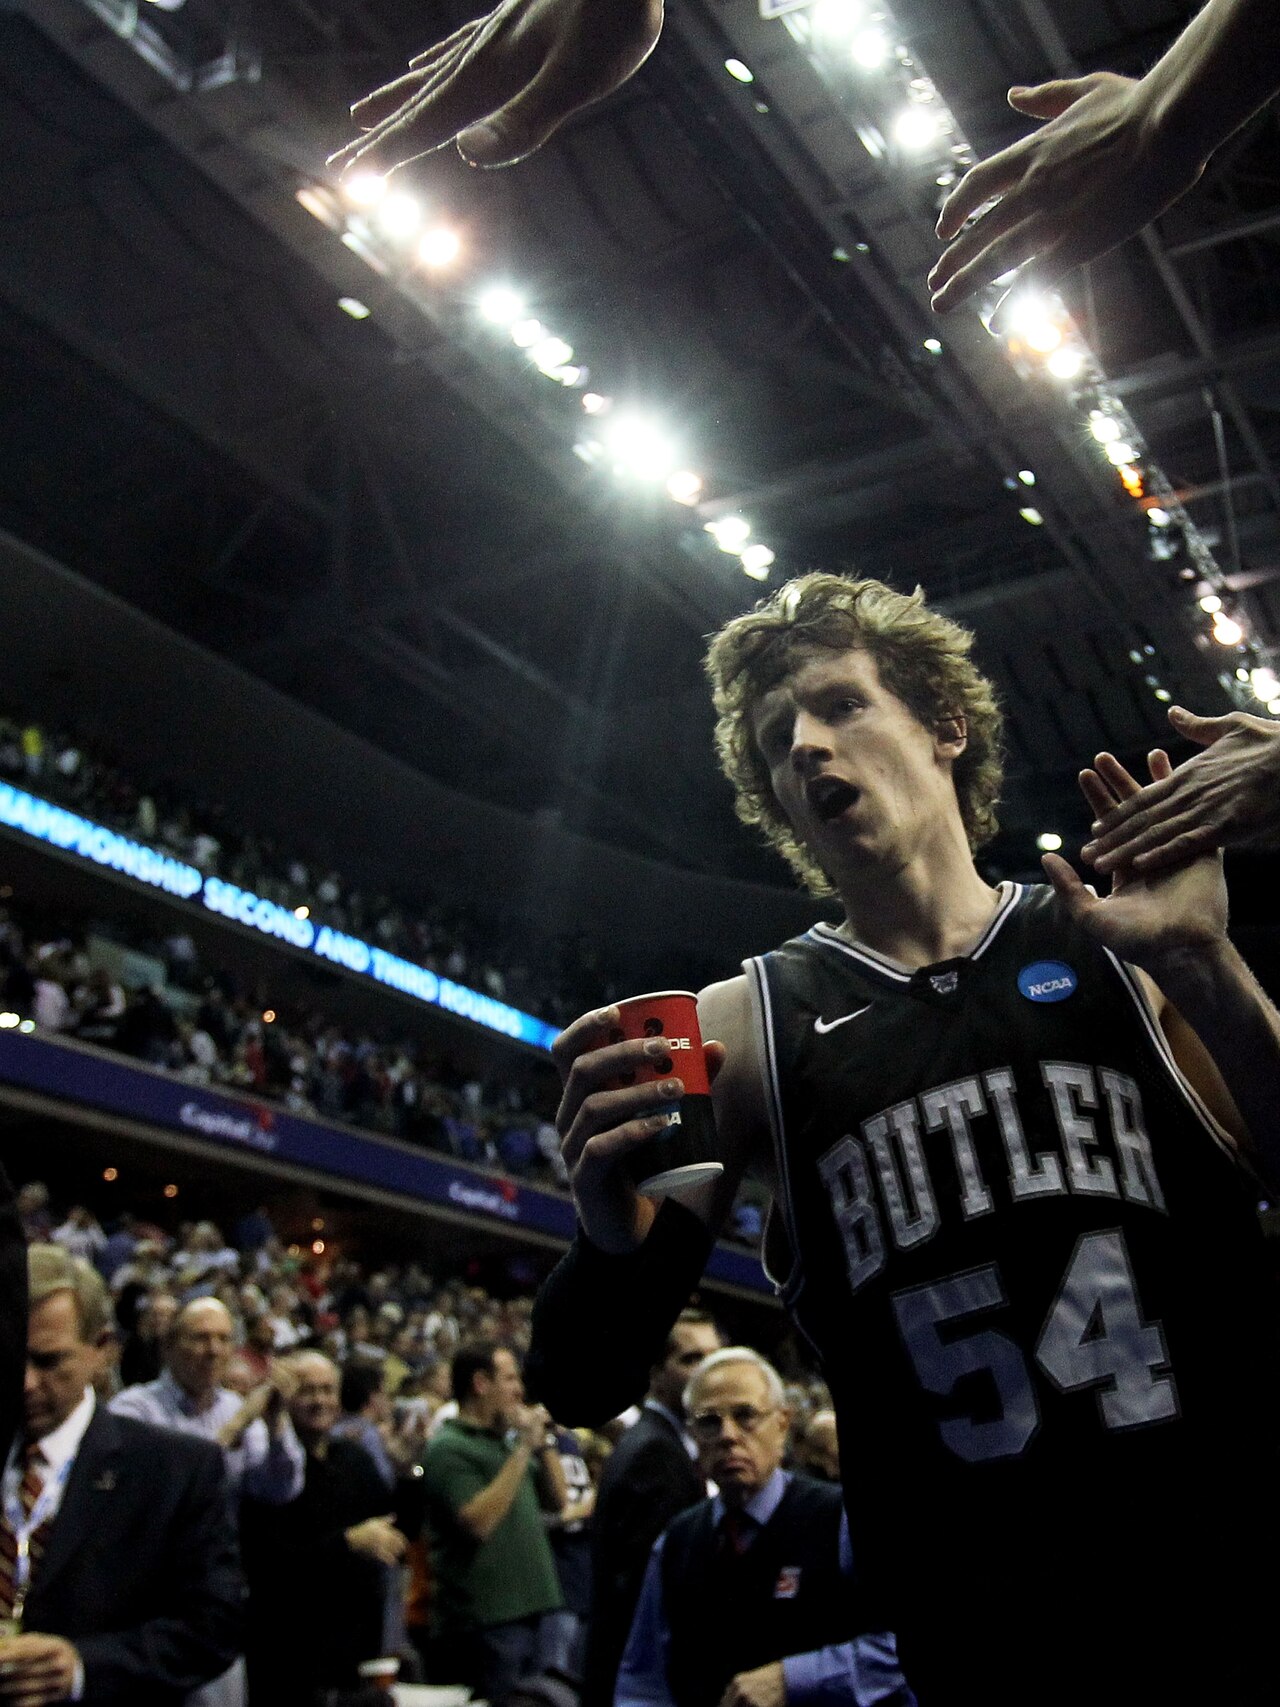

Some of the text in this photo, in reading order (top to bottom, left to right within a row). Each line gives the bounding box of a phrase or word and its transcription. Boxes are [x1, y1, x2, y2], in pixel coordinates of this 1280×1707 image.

[203, 877, 314, 948] SECOND
[315, 926, 370, 972] AND
[369, 947, 439, 1002] THIRD
[438, 978, 523, 1038] ROUNDS
[1028, 977, 1073, 997] NCAA
[669, 1038, 691, 1050] DE
[816, 1060, 1170, 1296] BUTLER
[889, 1226, 1183, 1464] 54
